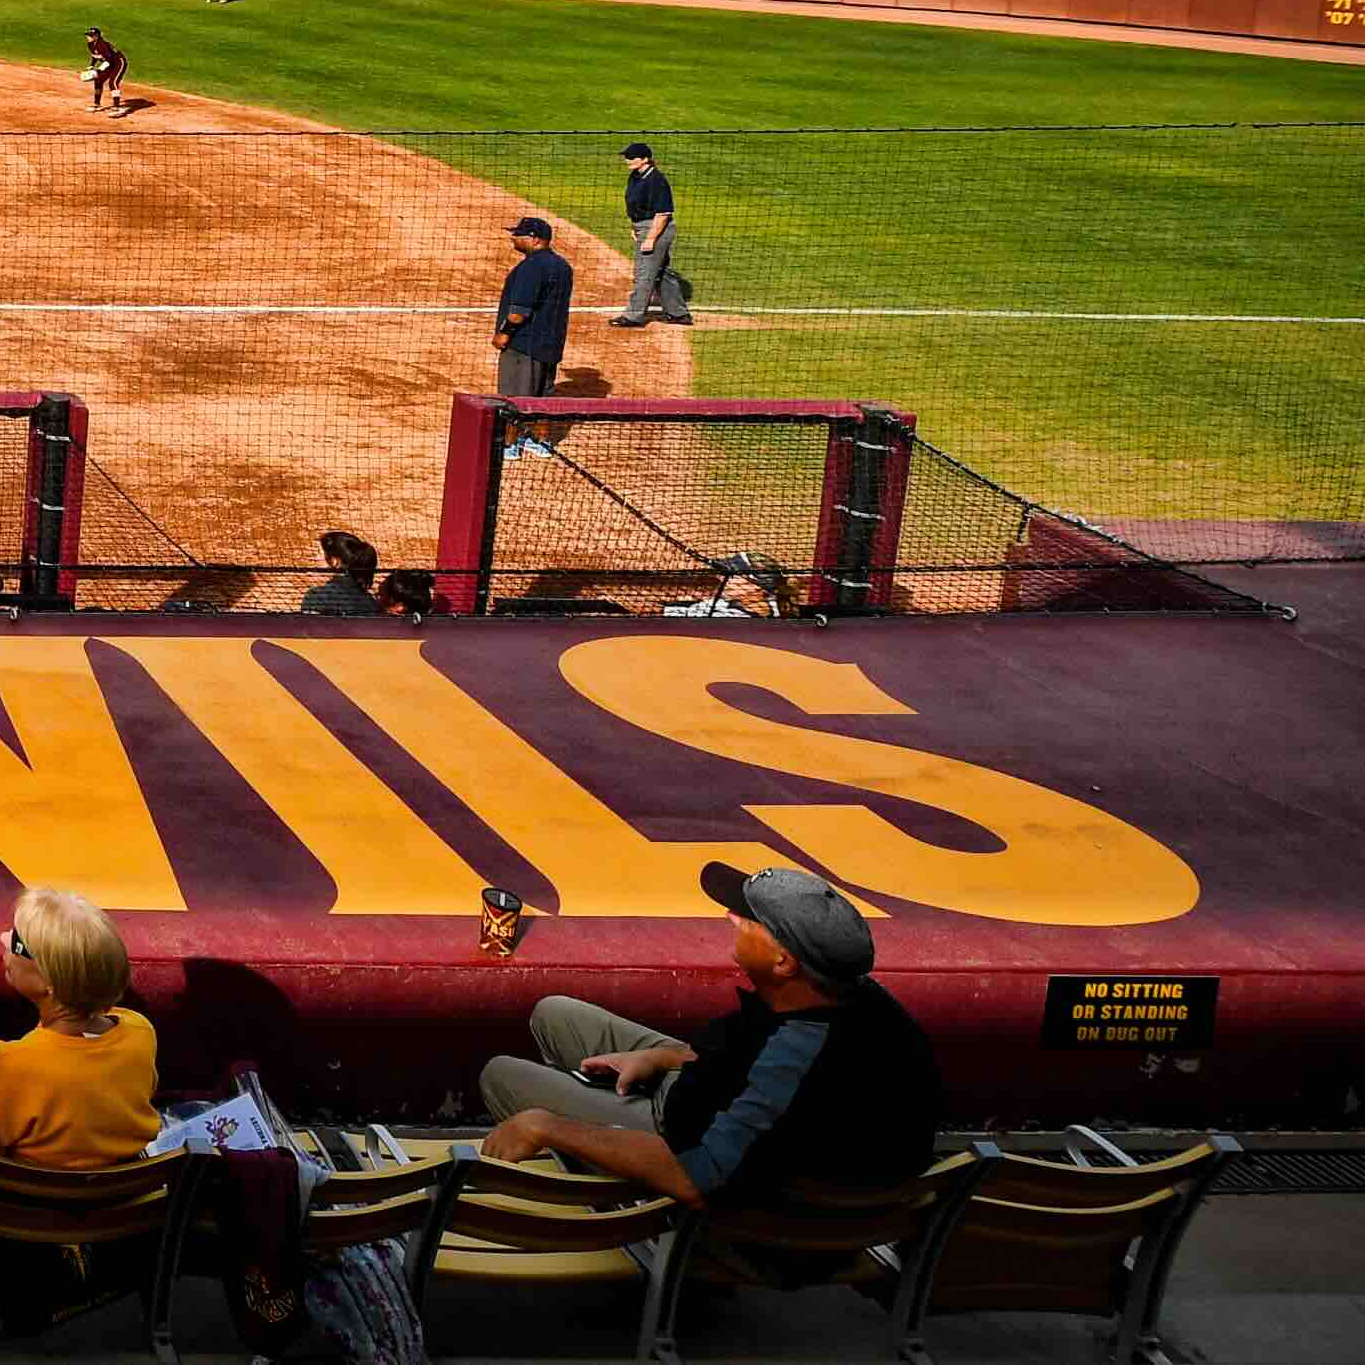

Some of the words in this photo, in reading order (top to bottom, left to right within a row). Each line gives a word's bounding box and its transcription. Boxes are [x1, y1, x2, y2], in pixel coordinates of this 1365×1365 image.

[489, 921, 516, 938] ASU
[1084, 982, 1108, 998] NO
[1111, 983, 1184, 999] SITTING
[1072, 1004, 1095, 1019] OR
[1100, 1004, 1189, 1020] STANDING
[1076, 1026, 1100, 1041] ON
[1105, 1026, 1139, 1042] DUG
[1144, 1026, 1179, 1042] OUT
